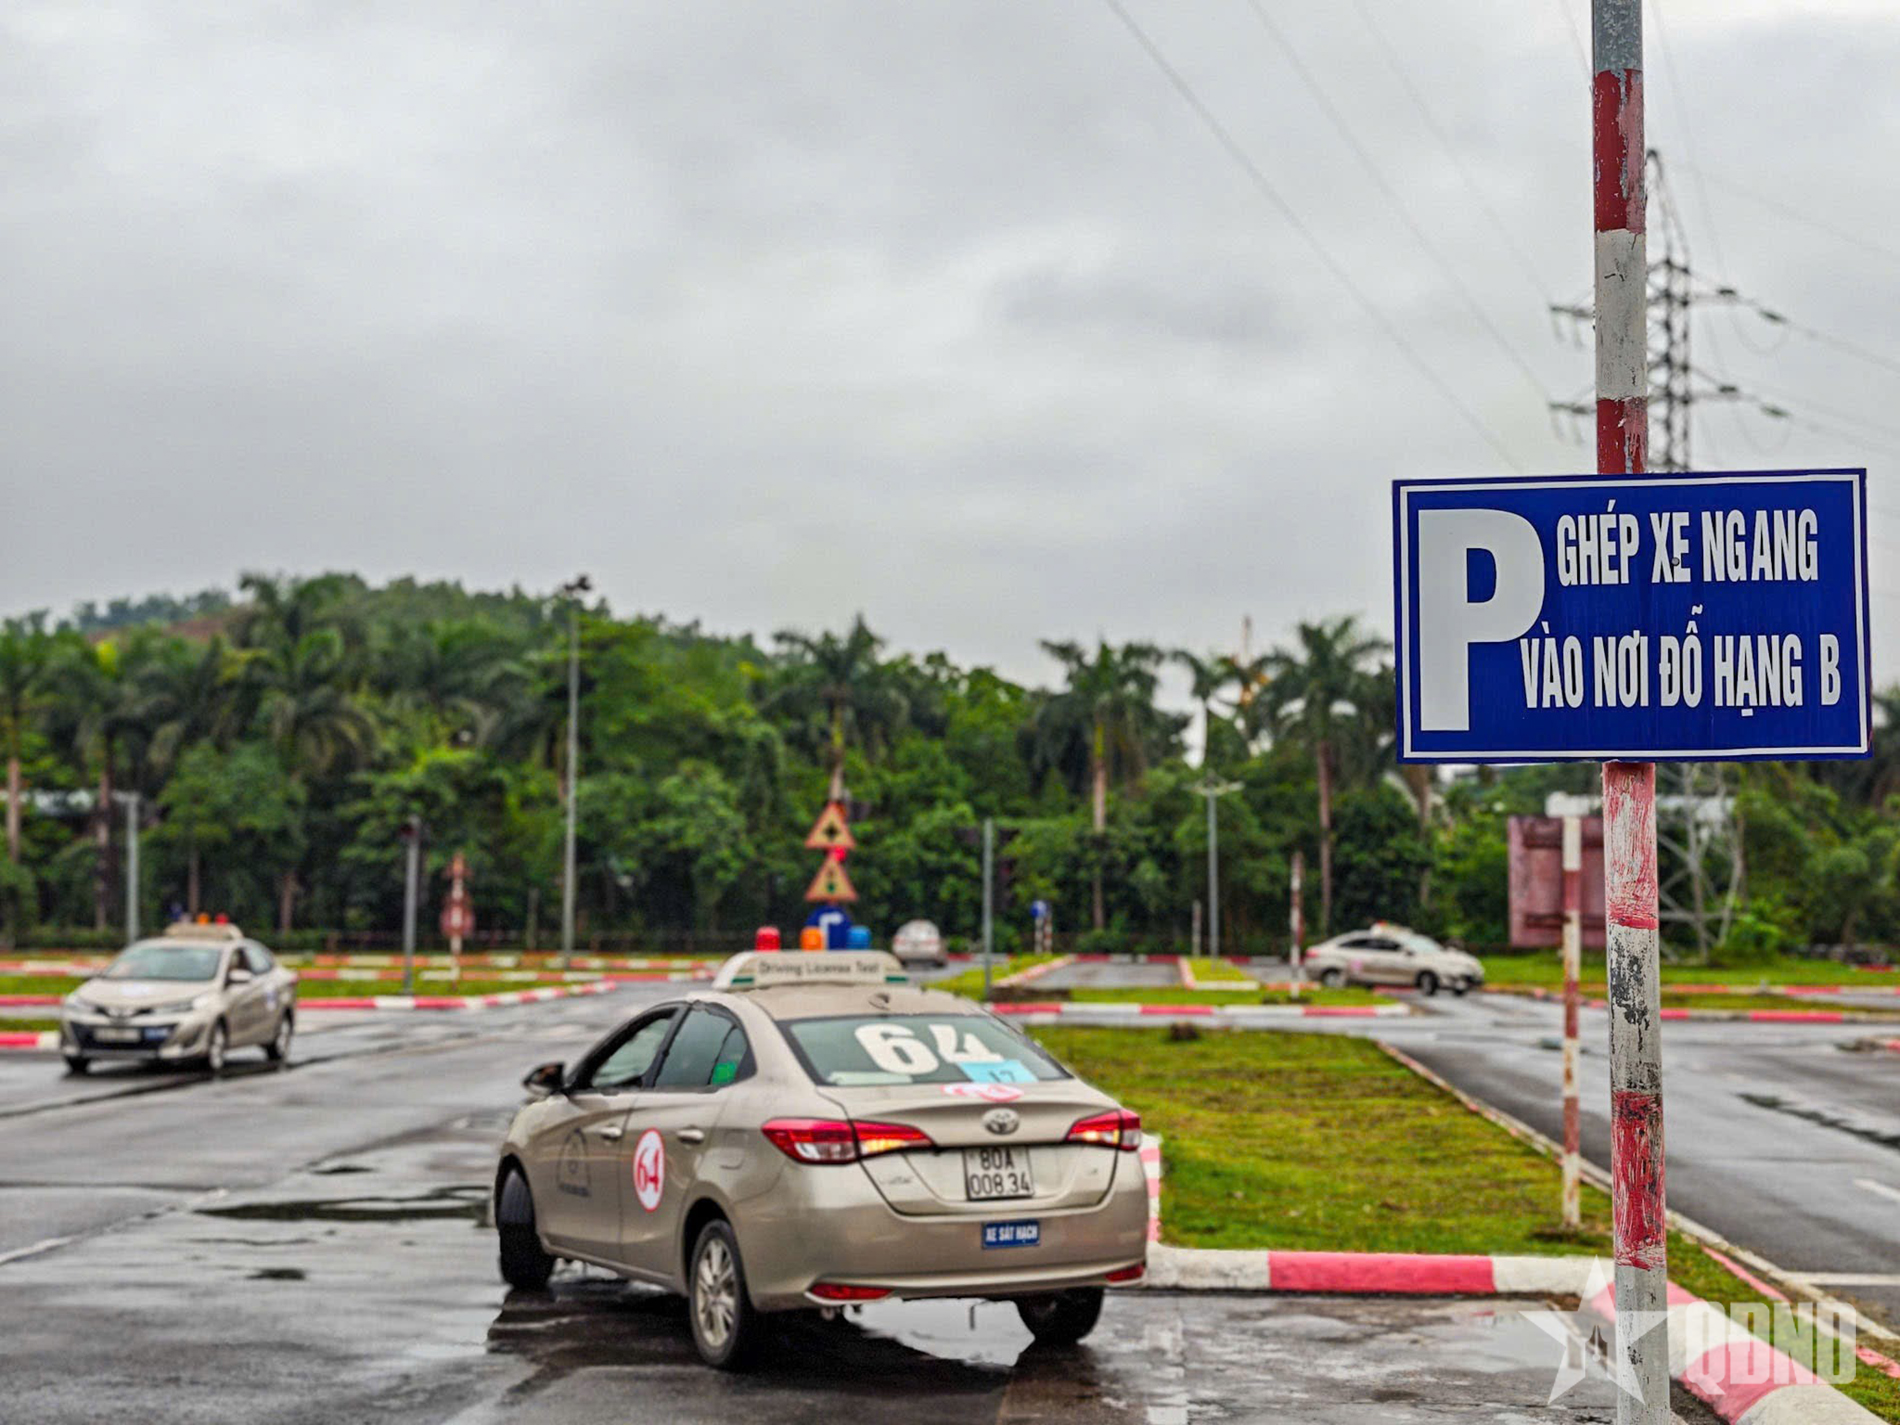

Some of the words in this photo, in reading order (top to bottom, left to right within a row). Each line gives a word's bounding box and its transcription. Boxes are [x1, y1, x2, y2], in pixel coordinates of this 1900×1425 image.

[1556, 499, 1640, 586] GHÉP
[1649, 511, 1692, 583] XE
[1701, 509, 1819, 583] NGANG
[1417, 508, 1545, 731] P
[1519, 621, 1584, 709] VÀO
[1593, 630, 1649, 708] NƠI
[1659, 604, 1703, 708] ĐỖ
[1714, 634, 1804, 717] HẠNG
[1819, 633, 1841, 706] B
[854, 1023, 1005, 1076] 64
[637, 1146, 660, 1193] 64
[979, 1146, 1015, 1171] 80A
